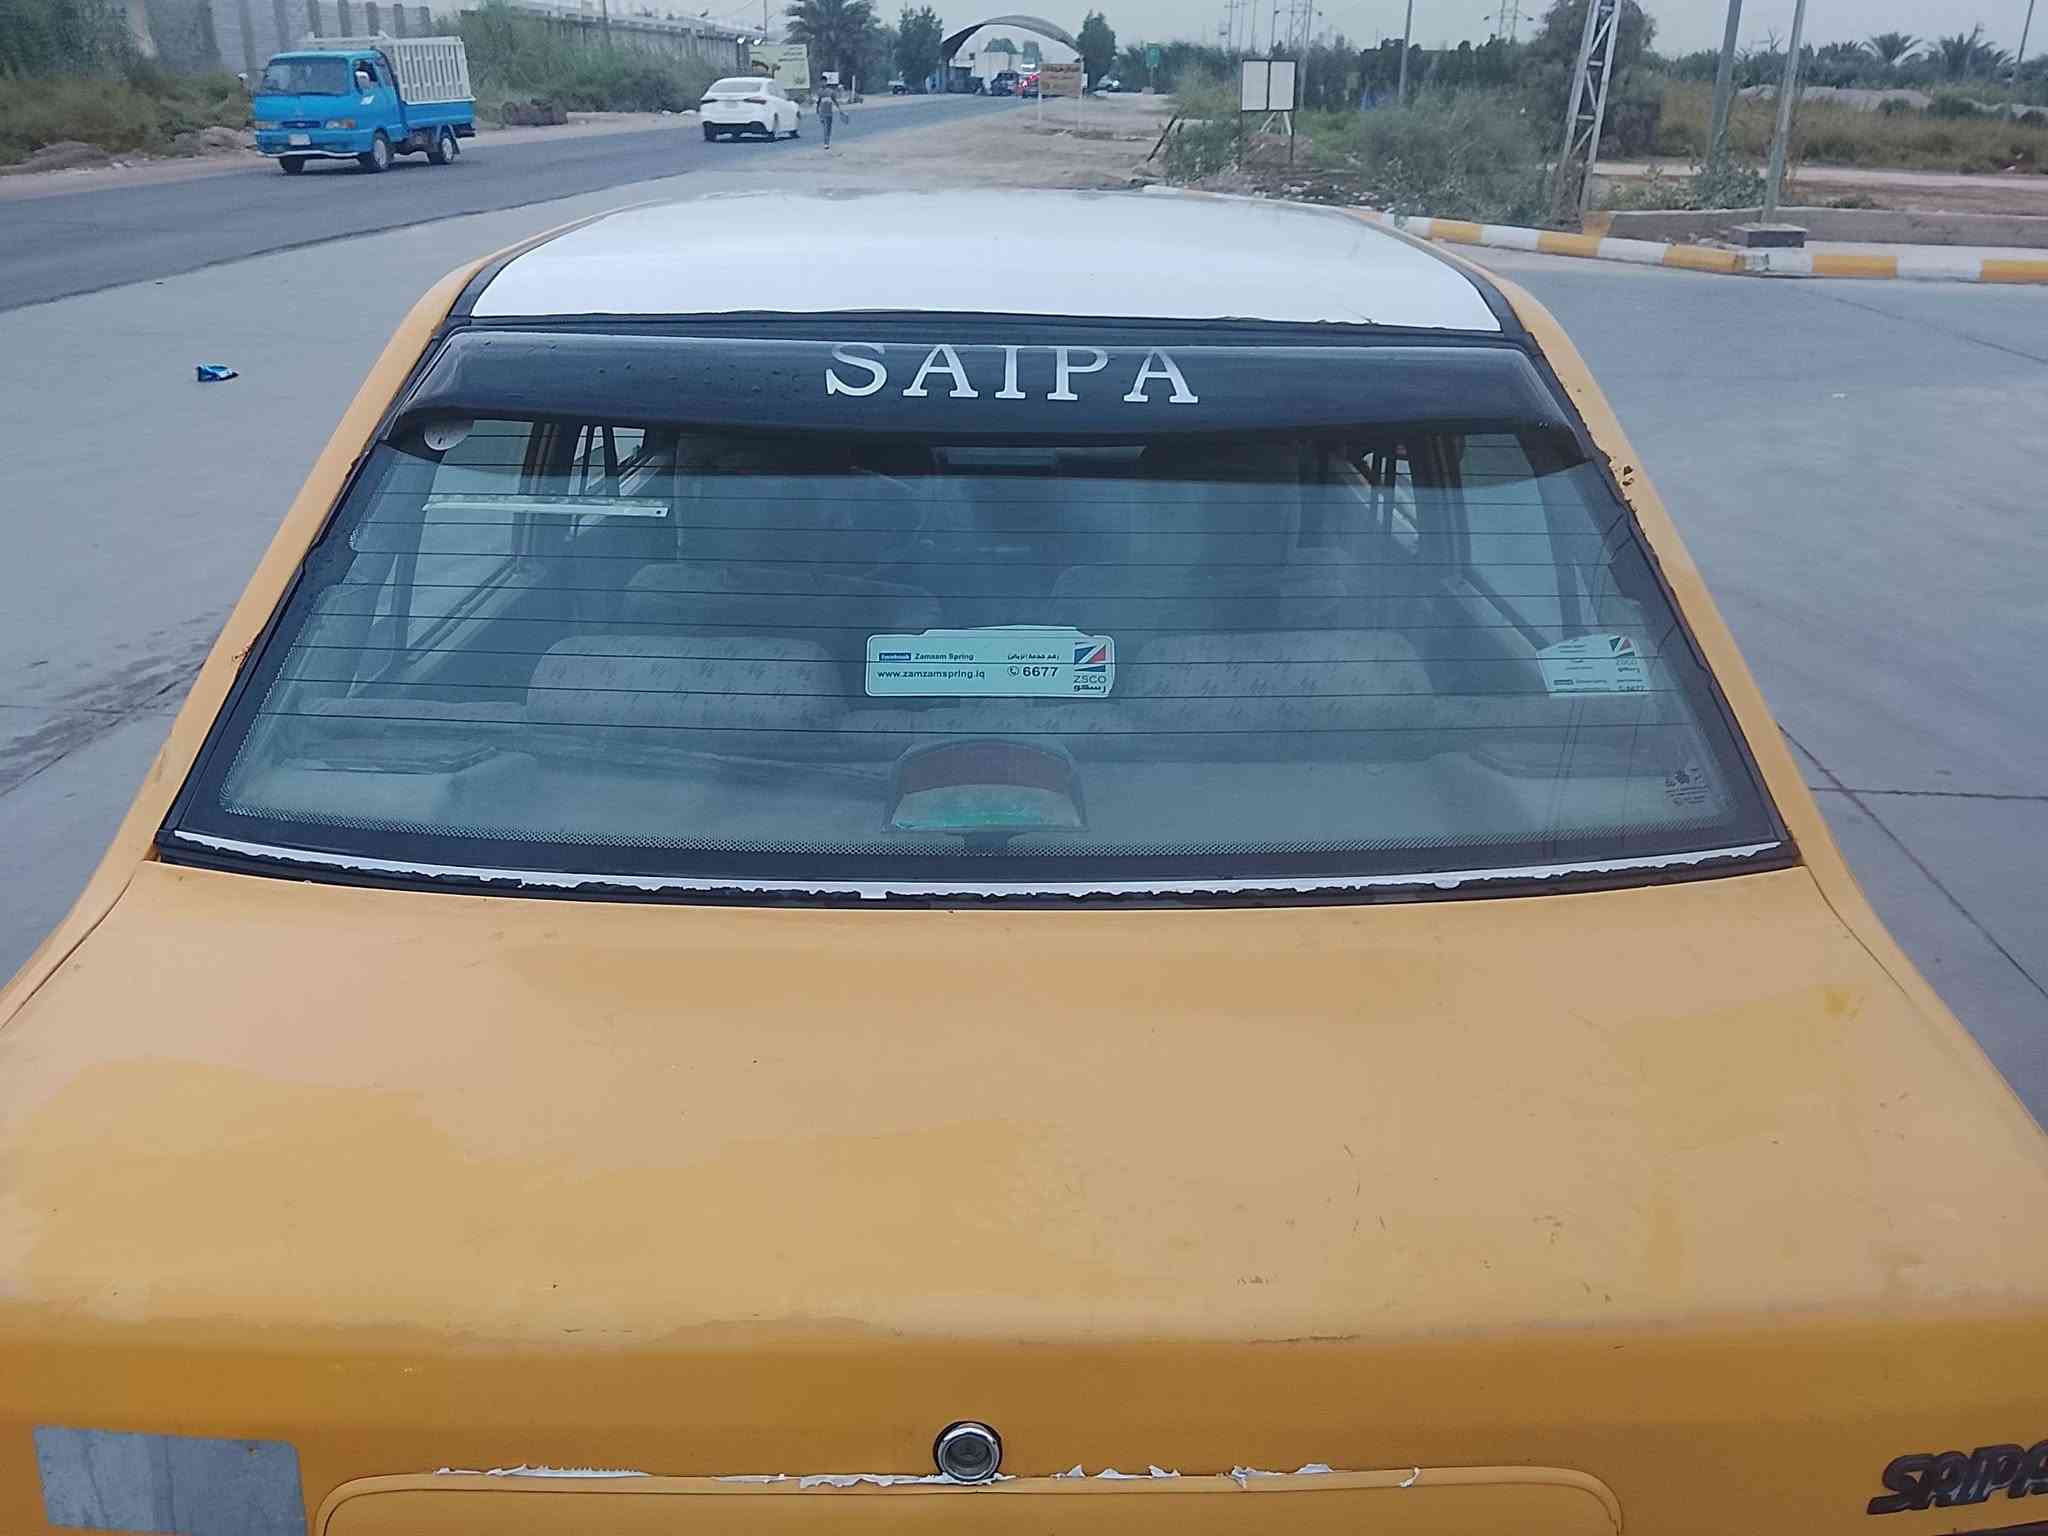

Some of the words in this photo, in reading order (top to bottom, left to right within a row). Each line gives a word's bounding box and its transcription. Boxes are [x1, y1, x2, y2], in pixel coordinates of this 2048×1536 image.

[825, 342, 1199, 403] SAIPA
[877, 670, 985, 679] www.zamzamspring.iq
[1022, 666, 1058, 677] 6677
[1073, 675, 1107, 684] ZSCO
